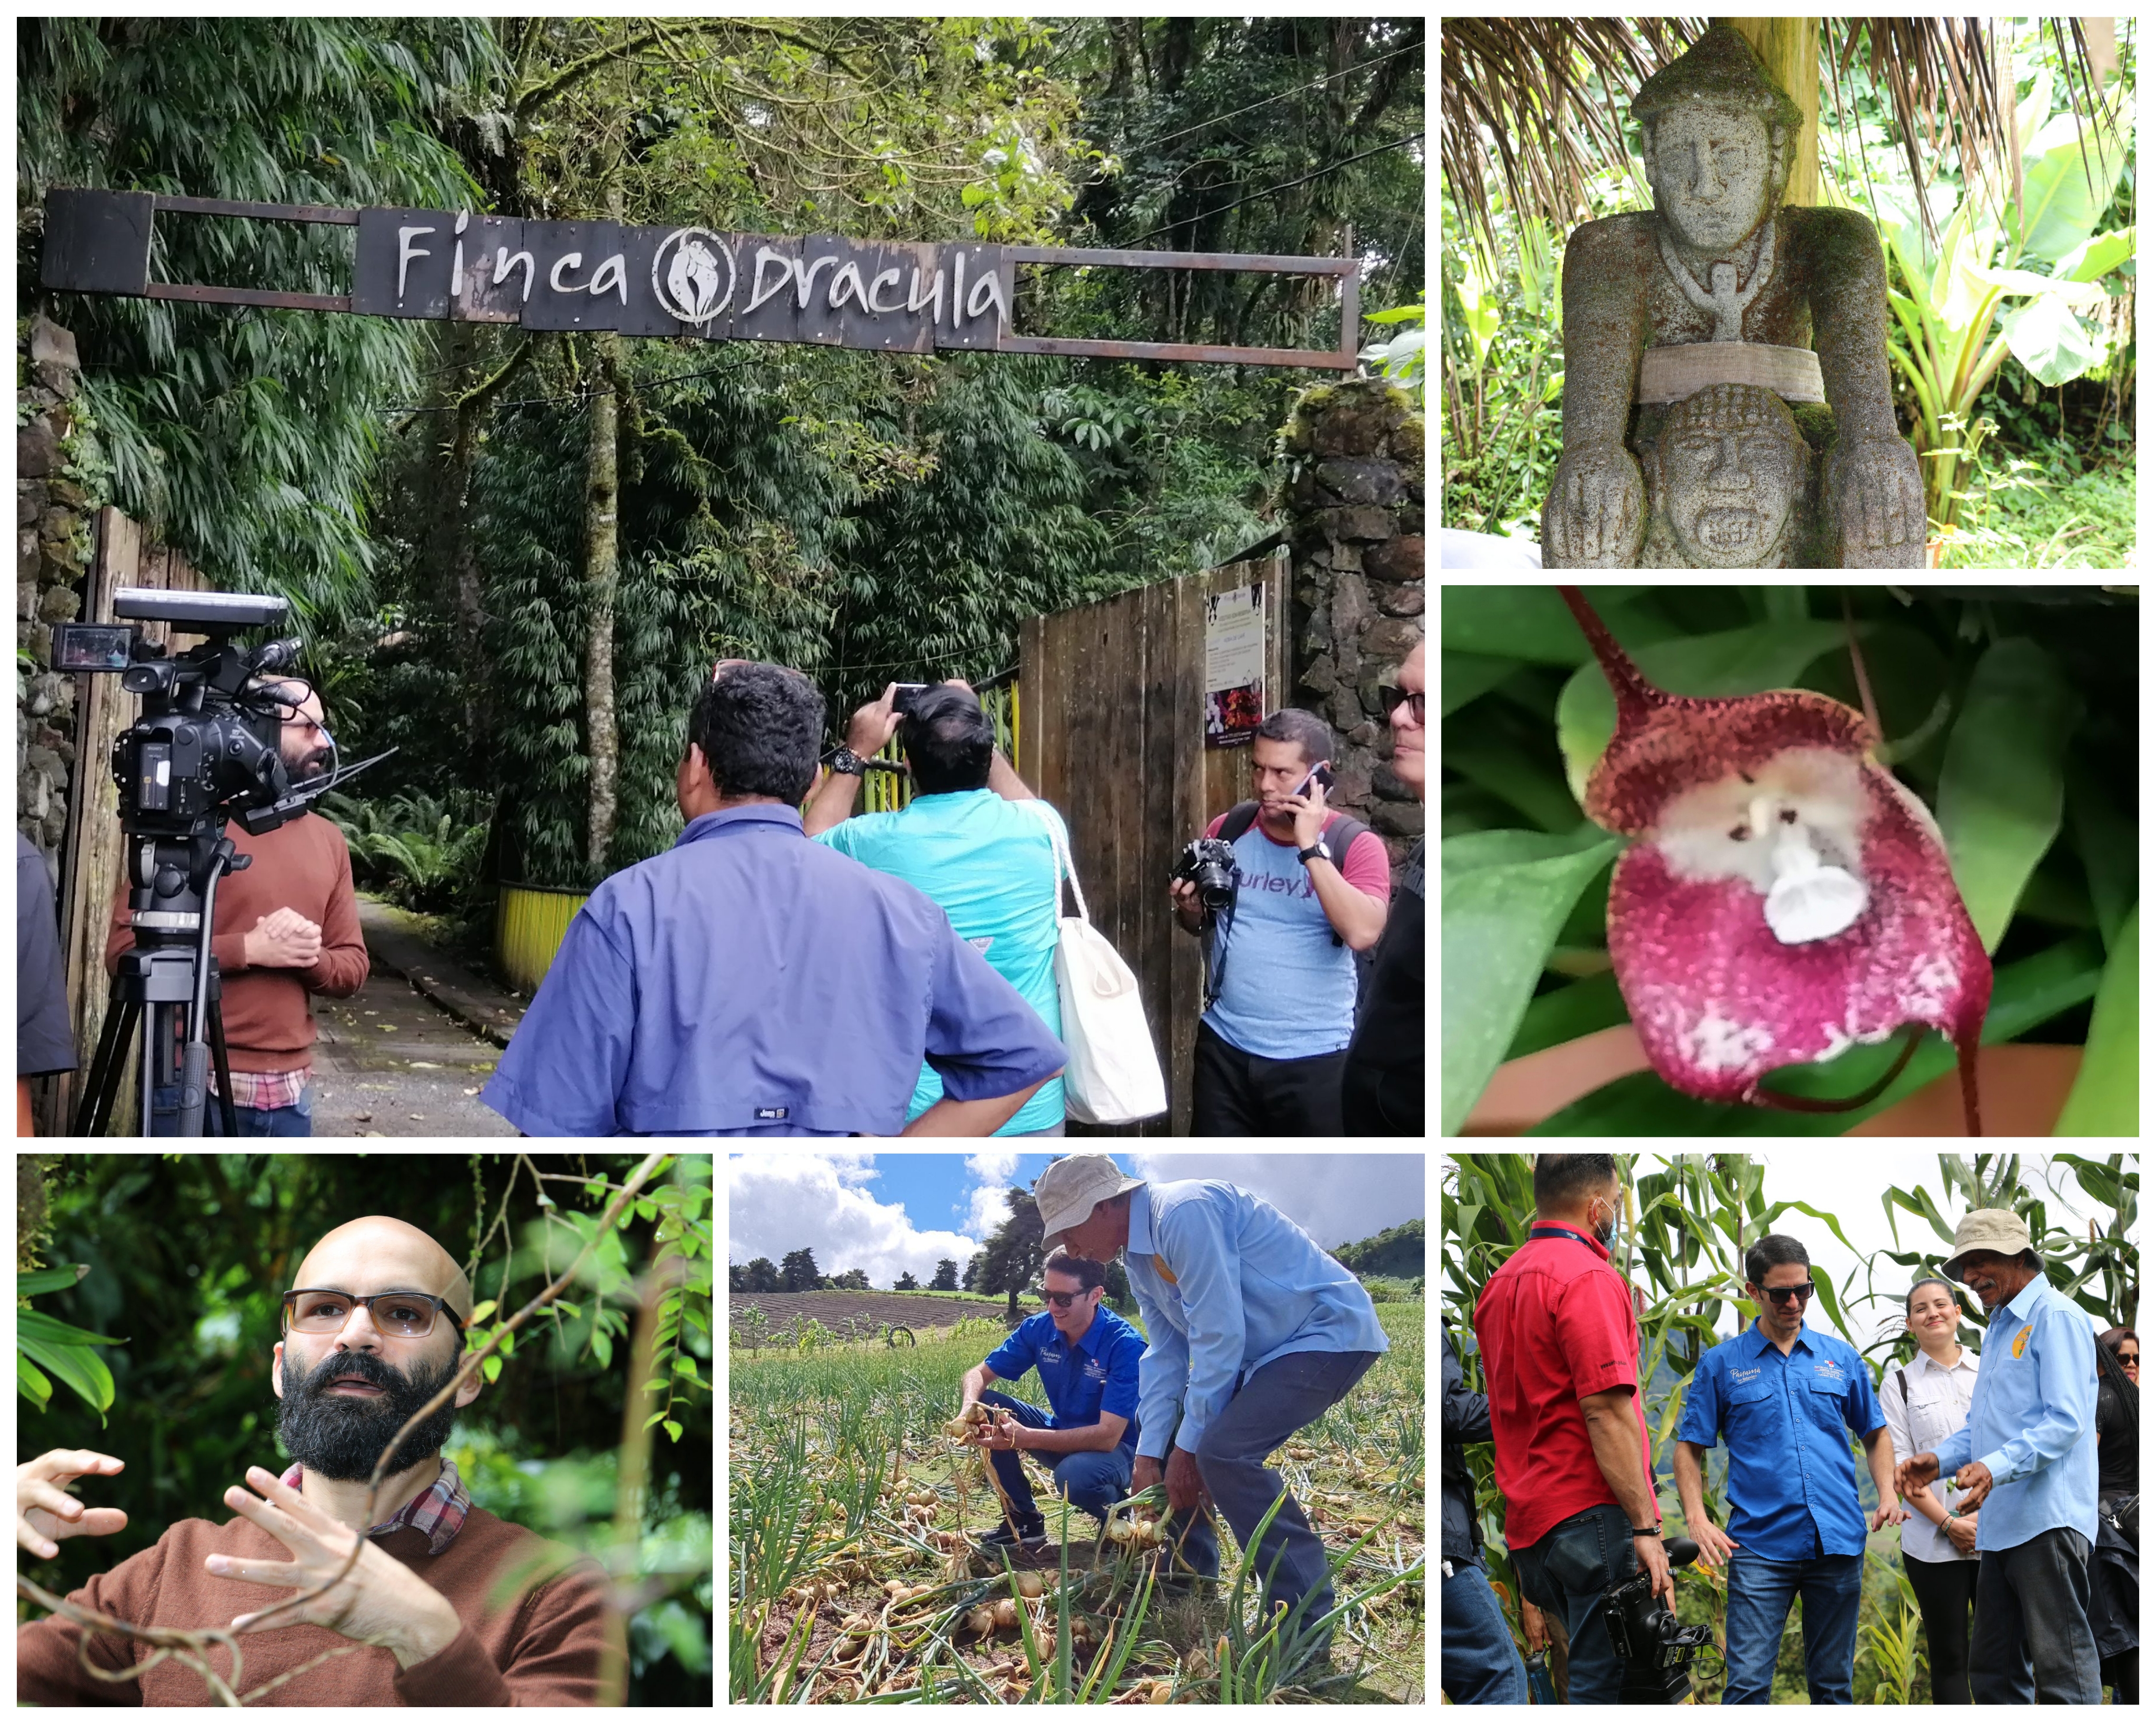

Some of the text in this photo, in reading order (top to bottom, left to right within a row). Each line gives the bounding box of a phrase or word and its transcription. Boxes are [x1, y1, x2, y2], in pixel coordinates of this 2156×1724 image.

[398, 209, 1007, 329] Finca Dracula
[1238, 871, 1302, 896] urley
[1730, 1366, 1761, 1379] Panamá
